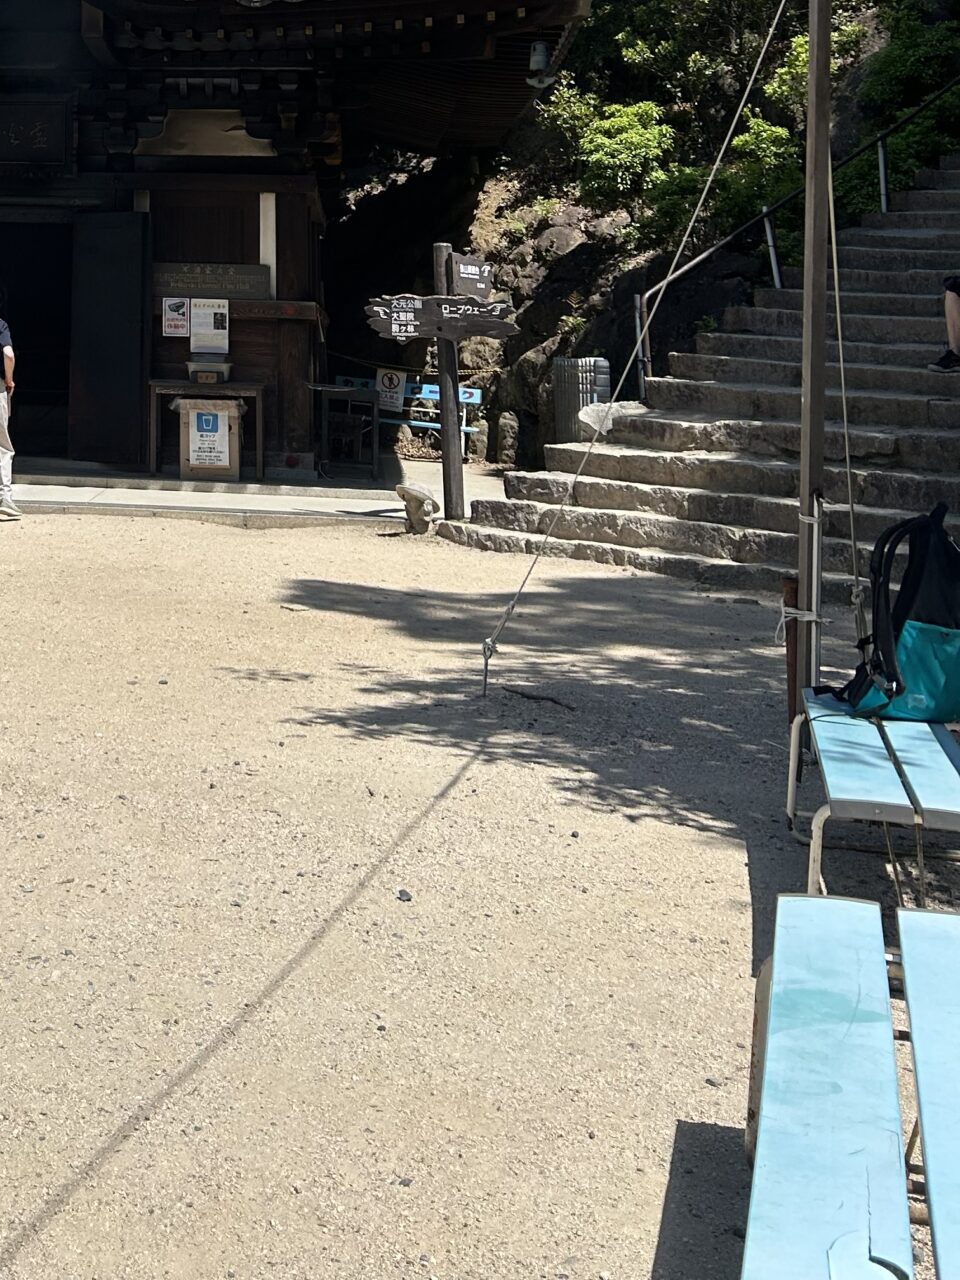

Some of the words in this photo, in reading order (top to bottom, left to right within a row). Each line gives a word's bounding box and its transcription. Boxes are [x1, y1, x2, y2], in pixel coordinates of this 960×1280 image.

[442, 304, 487, 314] ロープウェー
